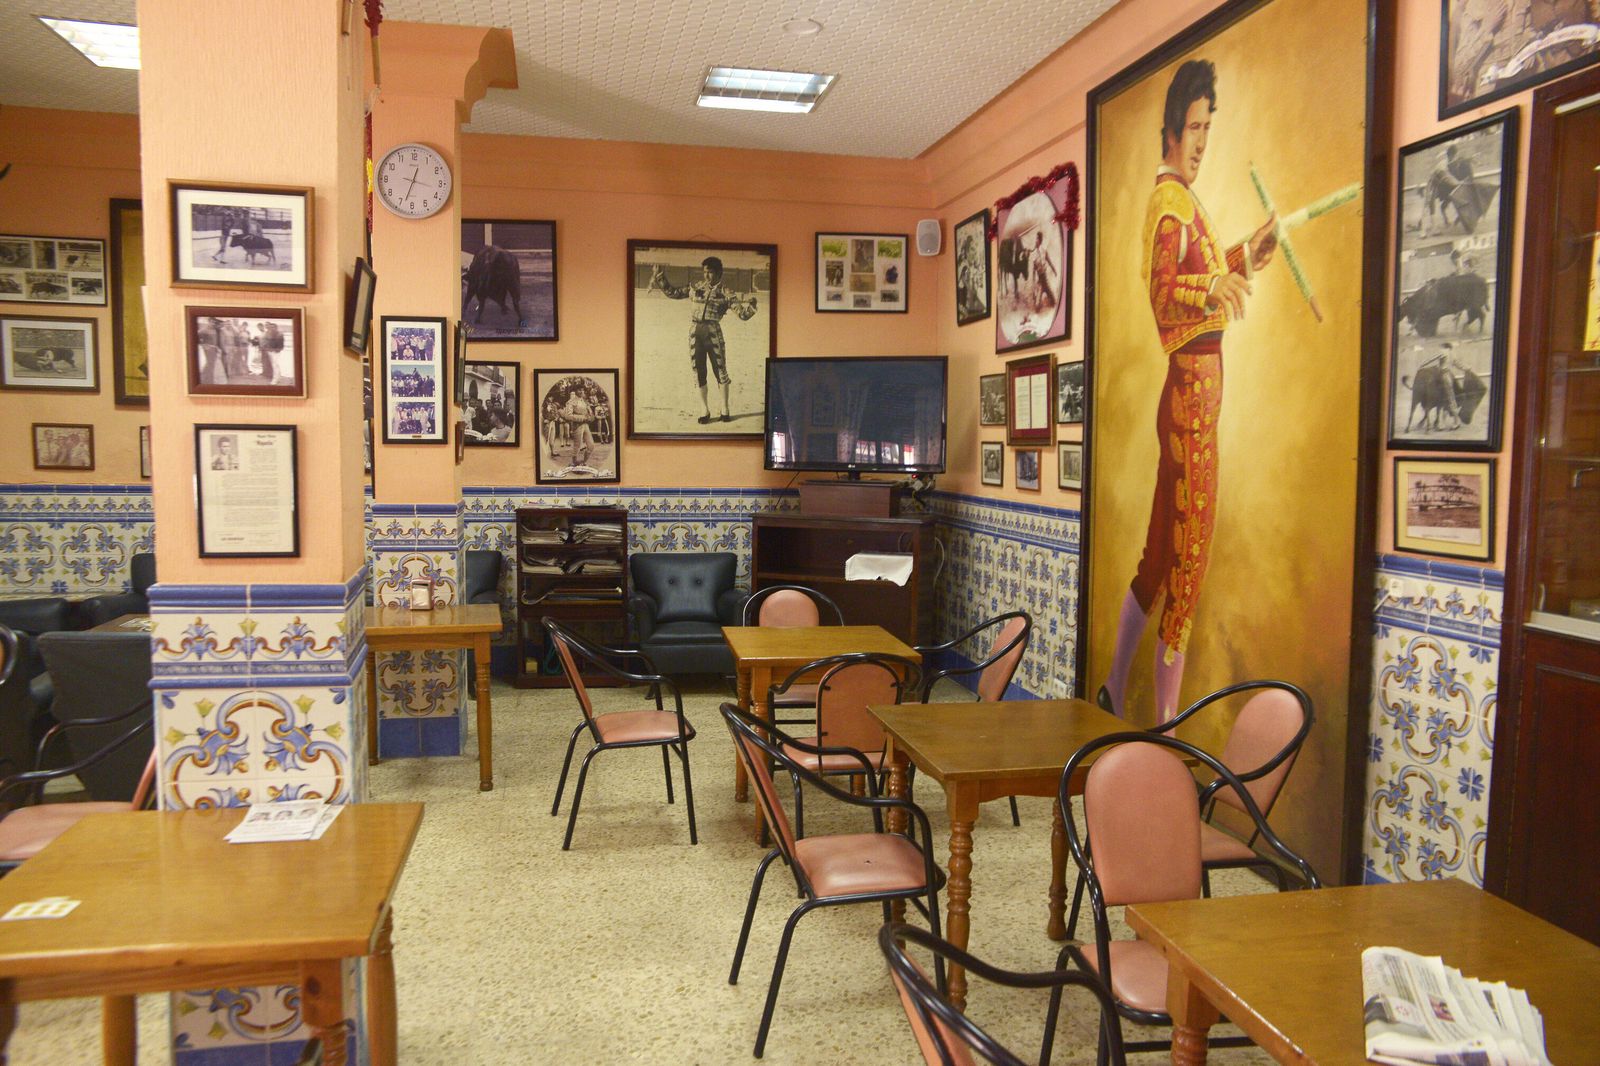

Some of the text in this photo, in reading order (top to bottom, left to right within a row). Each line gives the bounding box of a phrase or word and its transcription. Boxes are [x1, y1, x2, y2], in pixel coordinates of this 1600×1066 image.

[398, 155, 404, 163] 11
[411, 152, 418, 160] 12
[434, 166, 438, 174] 2
[384, 175, 388, 183] 9
[388, 188, 392, 196] 8
[410, 202, 414, 210] 6
